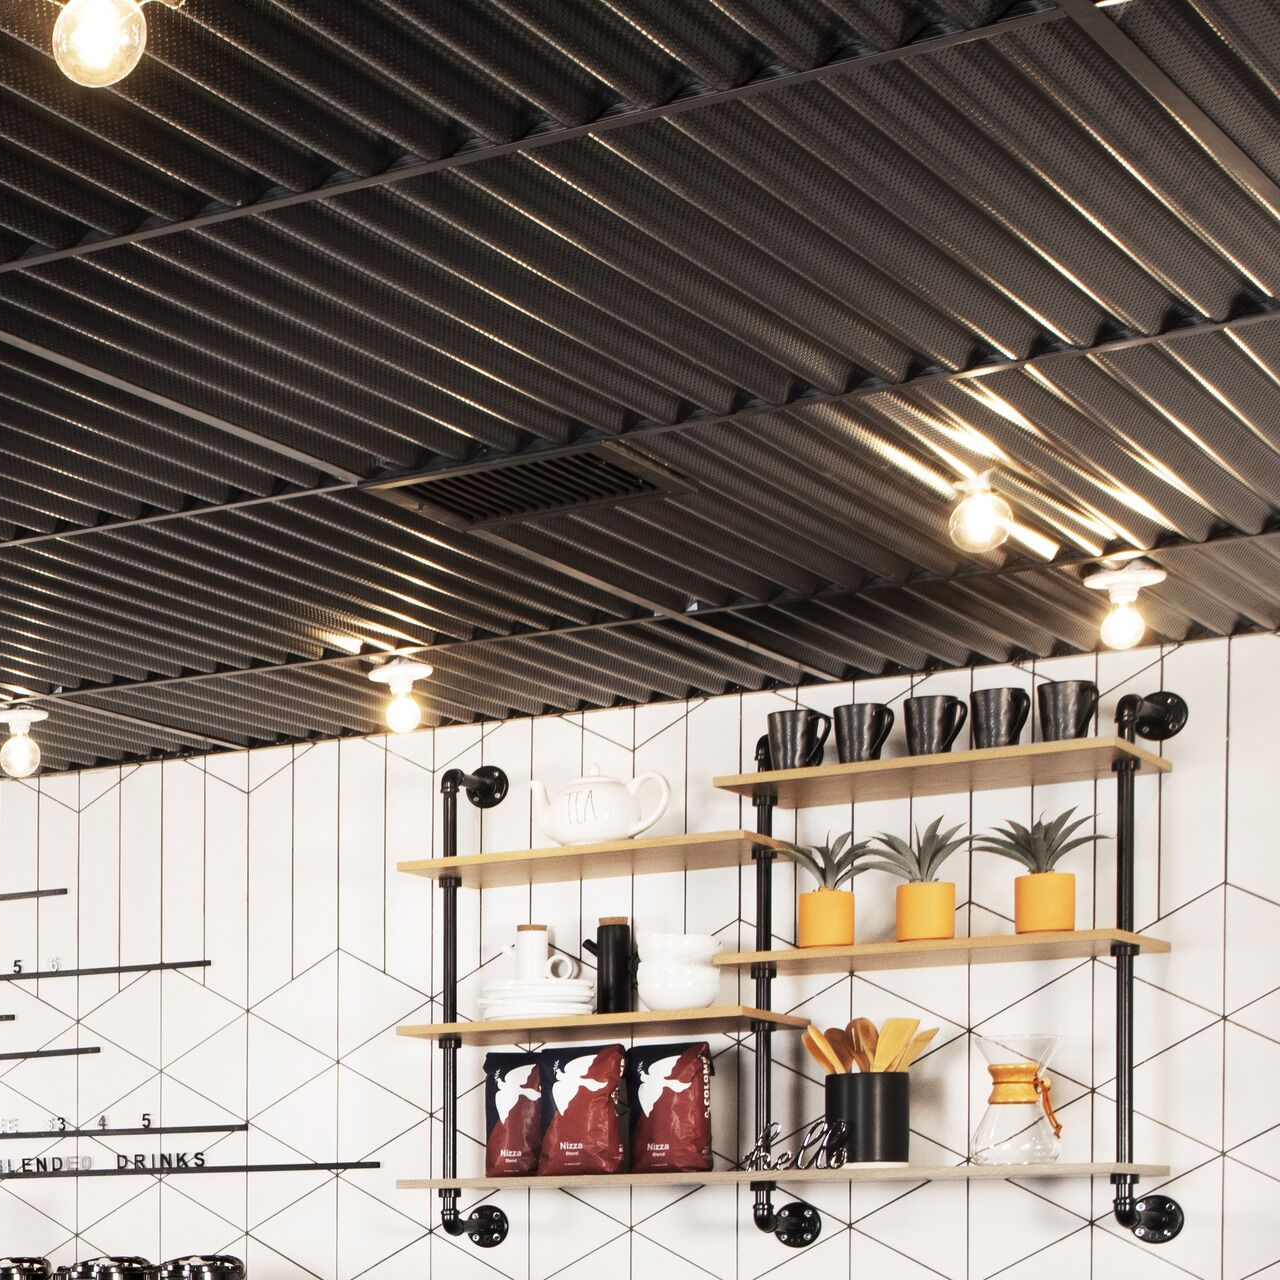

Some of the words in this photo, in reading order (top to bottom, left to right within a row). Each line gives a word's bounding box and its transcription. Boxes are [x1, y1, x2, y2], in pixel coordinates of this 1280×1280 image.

[564, 790, 599, 825] TEA
[13, 959, 23, 974] 5
[50, 957, 61, 972] 6
[48, 1117, 66, 1132] $3
[98, 1115, 107, 1130] 4
[142, 1113, 152, 1128] 5
[500, 1149, 522, 1157] Nizza
[560, 1142, 583, 1150] Nizza
[647, 1143, 670, 1151] Nizza
[743, 1121, 848, 1172] hello
[117, 1152, 206, 1169] DRINKS
